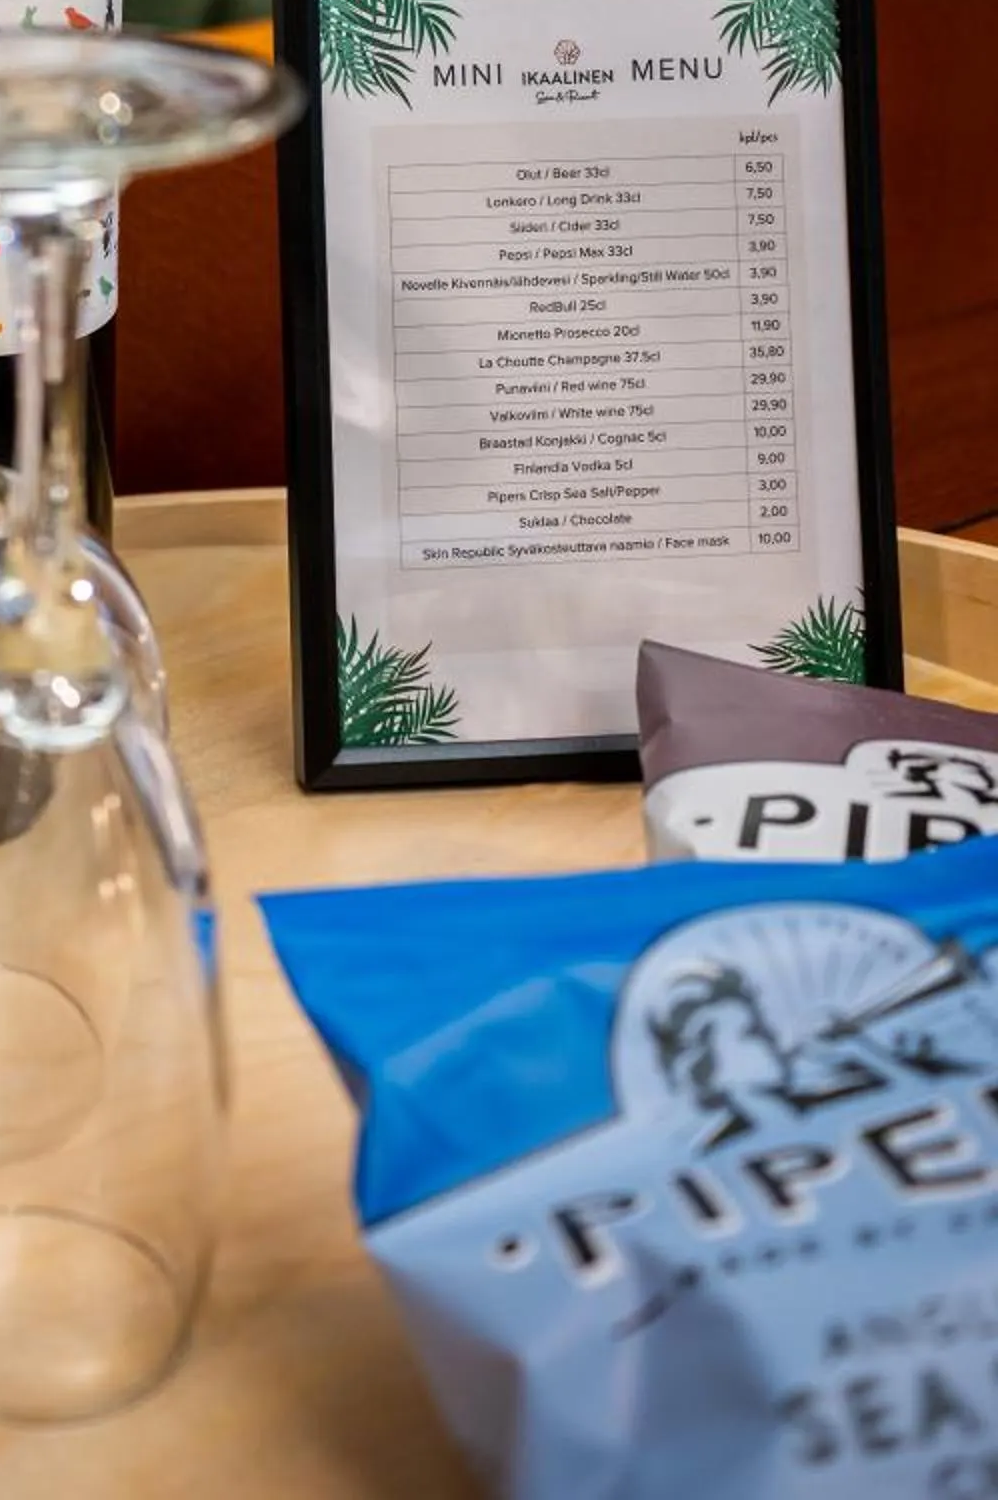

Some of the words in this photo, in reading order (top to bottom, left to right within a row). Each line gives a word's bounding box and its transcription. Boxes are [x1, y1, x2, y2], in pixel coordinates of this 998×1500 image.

[433, 63, 503, 87] MINI
[521, 69, 614, 85] IKAALINEN
[631, 57, 723, 82] MENU
[515, 168, 541, 181] Olut
[552, 166, 582, 179] Beer
[583, 165, 610, 179] 33cl
[486, 195, 537, 211] Lonkero
[546, 194, 577, 210] Long
[579, 192, 612, 205] Drink
[615, 190, 641, 204] 33cl
[557, 219, 591, 232] Cider
[594, 218, 620, 231] 33cl
[498, 248, 532, 261] Pepsi
[542, 246, 577, 260] Pepsi
[579, 246, 604, 259] Max
[607, 244, 633, 257] 33cl
[401, 279, 448, 292] Novelle
[529, 299, 577, 314] RedBull
[579, 298, 606, 312] 25cl
[497, 327, 551, 342] Mionetto
[553, 325, 611, 340] Prosecco
[612, 324, 640, 337] 20cl
[478, 357, 493, 369] La
[547, 351, 621, 369] Champagne
[561, 379, 585, 393] Red
[587, 379, 617, 392] wine
[619, 376, 646, 389] 75cl
[558, 406, 593, 420] White
[595, 407, 626, 418] wine
[627, 403, 654, 417] 75cl
[597, 431, 644, 447] Cognac
[647, 430, 666, 443] 5cl
[513, 461, 569, 475] Finlandia
[571, 459, 611, 472] Vodka
[614, 458, 633, 471] 5cl
[487, 489, 526, 505] Pipers
[529, 488, 561, 502] Crisp
[562, 486, 587, 499] Sea
[518, 515, 560, 530] Suklaa
[569, 511, 632, 527] Chocolate
[423, 548, 448, 560] Skin
[451, 545, 504, 559] Republic
[609, 539, 654, 551] naamio
[665, 536, 694, 548] Face
[697, 535, 729, 547] mask
[550, 1086, 998, 1268] PIPE
